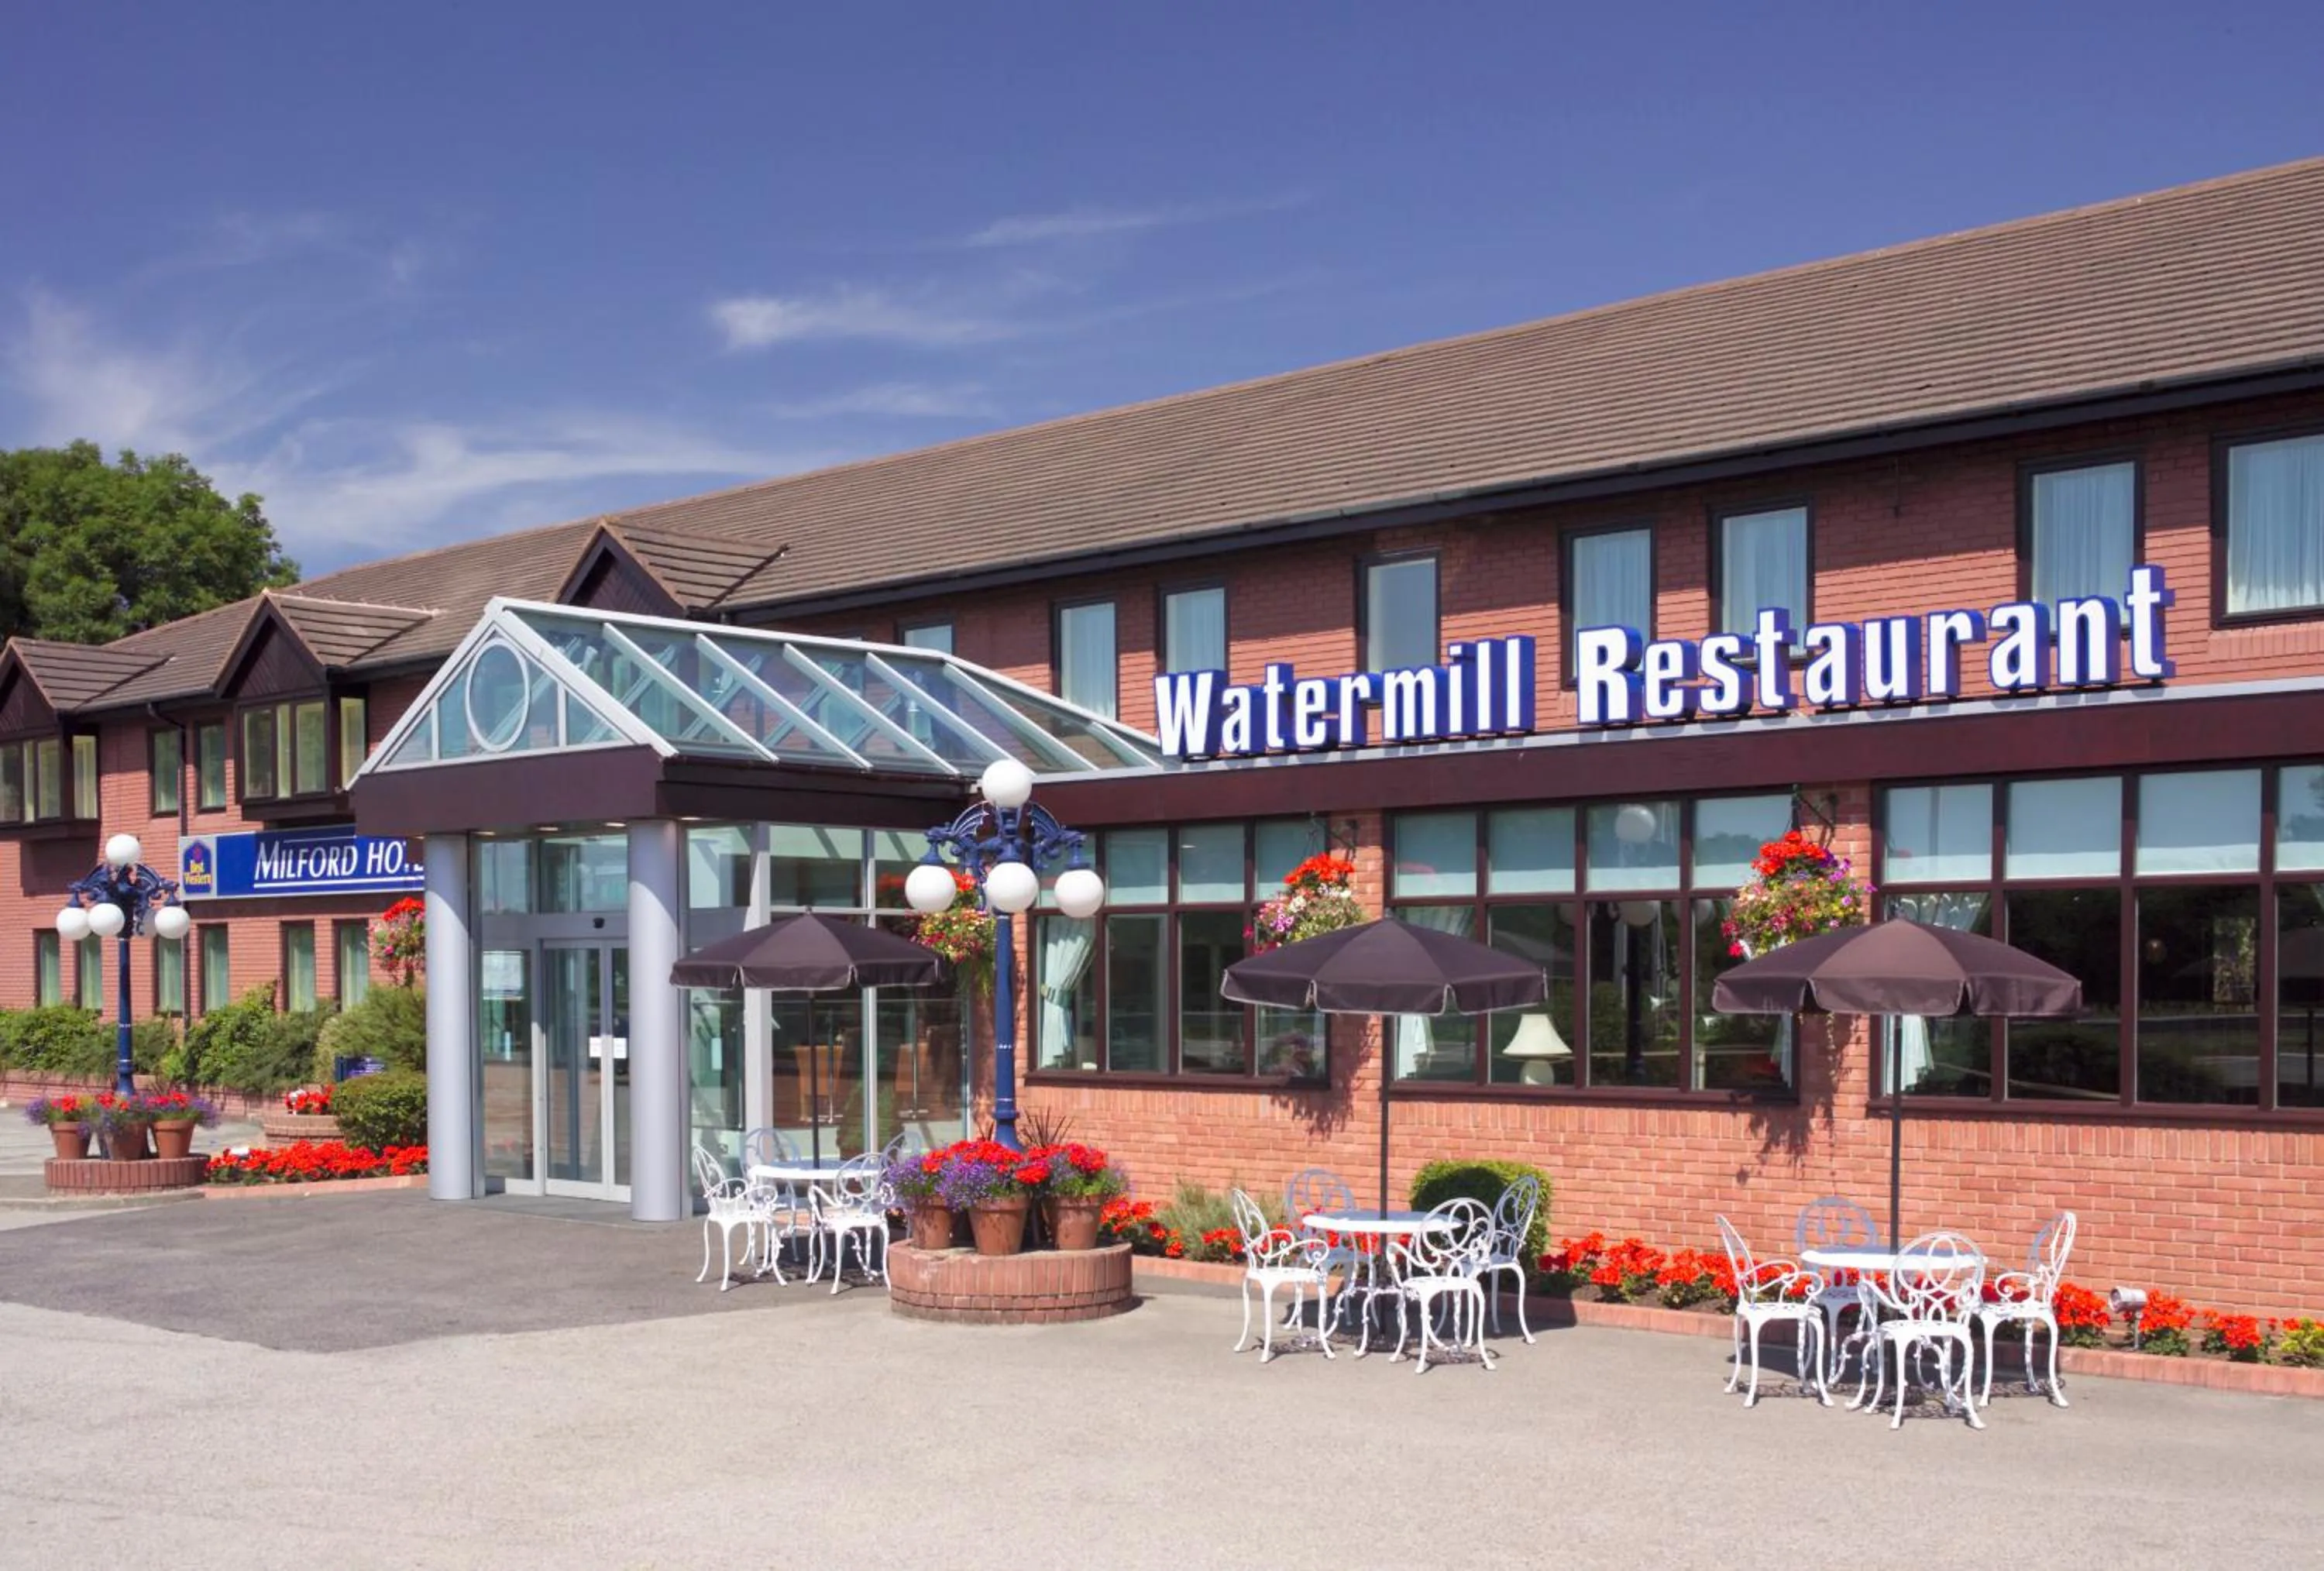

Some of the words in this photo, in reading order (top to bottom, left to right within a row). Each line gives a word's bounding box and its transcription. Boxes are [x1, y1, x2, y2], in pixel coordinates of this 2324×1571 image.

[1154, 634, 1536, 759] Watermill
[1576, 564, 2175, 727] Restaurant
[254, 841, 358, 881] MILFORD
[366, 841, 424, 875] HO
